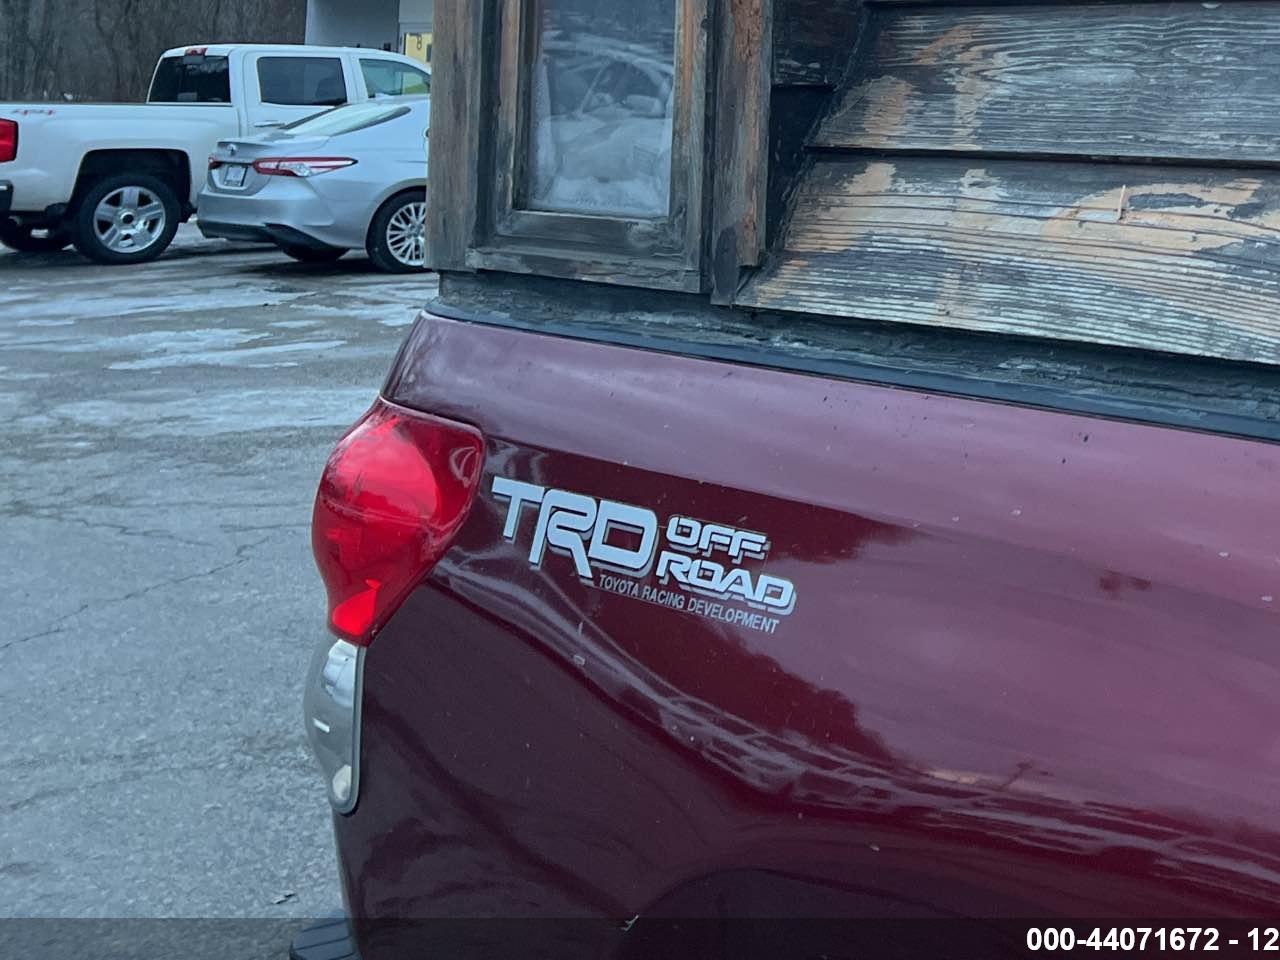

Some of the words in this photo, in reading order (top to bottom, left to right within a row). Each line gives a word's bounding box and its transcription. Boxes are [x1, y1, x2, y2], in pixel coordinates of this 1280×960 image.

[491, 475, 659, 583] TRD
[665, 515, 769, 560] OFF
[599, 573, 640, 598] TOYOTA
[641, 586, 685, 610] RACING
[687, 597, 780, 635] DEVELOPMENT
[655, 550, 796, 612] ROAD
